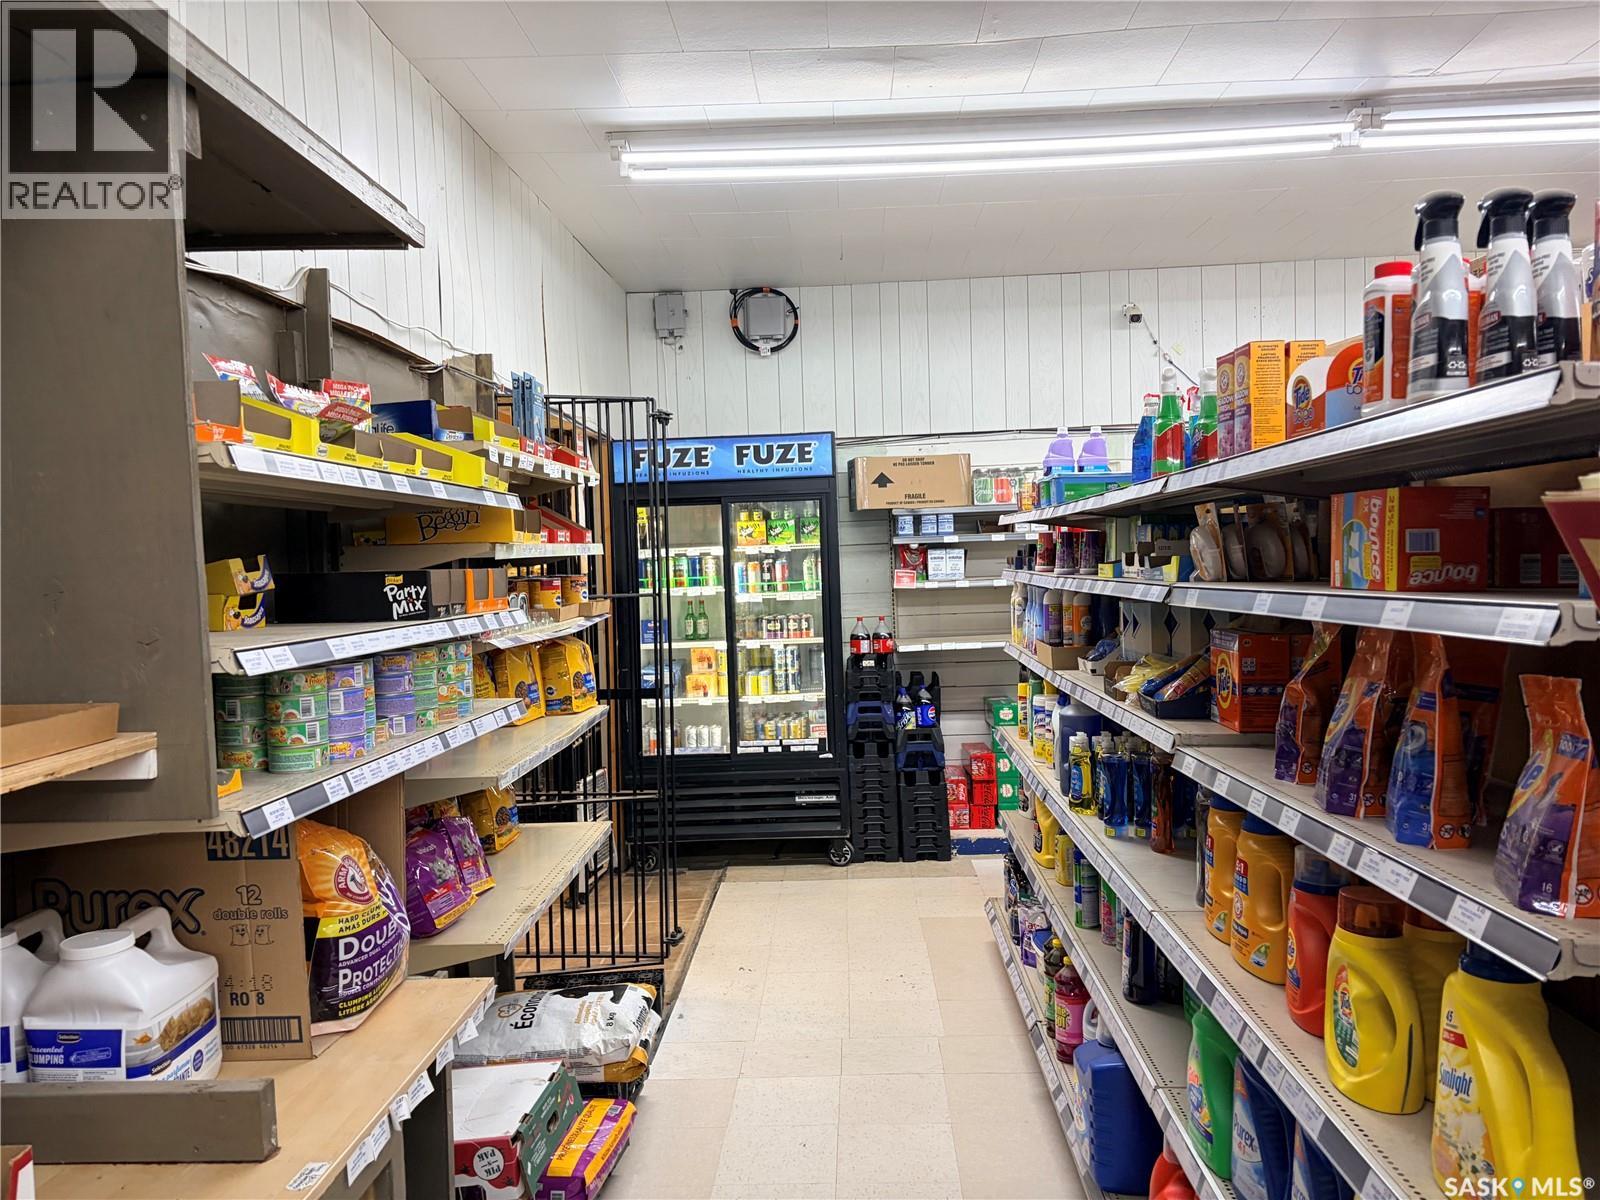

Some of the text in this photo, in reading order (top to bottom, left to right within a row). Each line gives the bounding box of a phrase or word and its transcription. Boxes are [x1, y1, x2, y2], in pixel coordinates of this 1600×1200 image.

[1369, 495, 1383, 582] bounce
[1409, 563, 1478, 586] bounce
[383, 584, 427, 602] Party
[392, 599, 424, 620] Mix
[235, 884, 263, 906] 12
[1542, 881, 1553, 894] 16
[213, 906, 289, 921] double rolls
[338, 914, 359, 925] HARD
[338, 921, 361, 934] AMAS
[230, 992, 265, 1006] RO 8
[1446, 1011, 1454, 1022] 45
[1438, 1062, 1473, 1097] Sunlight
[1234, 1112, 1256, 1150] Purex
